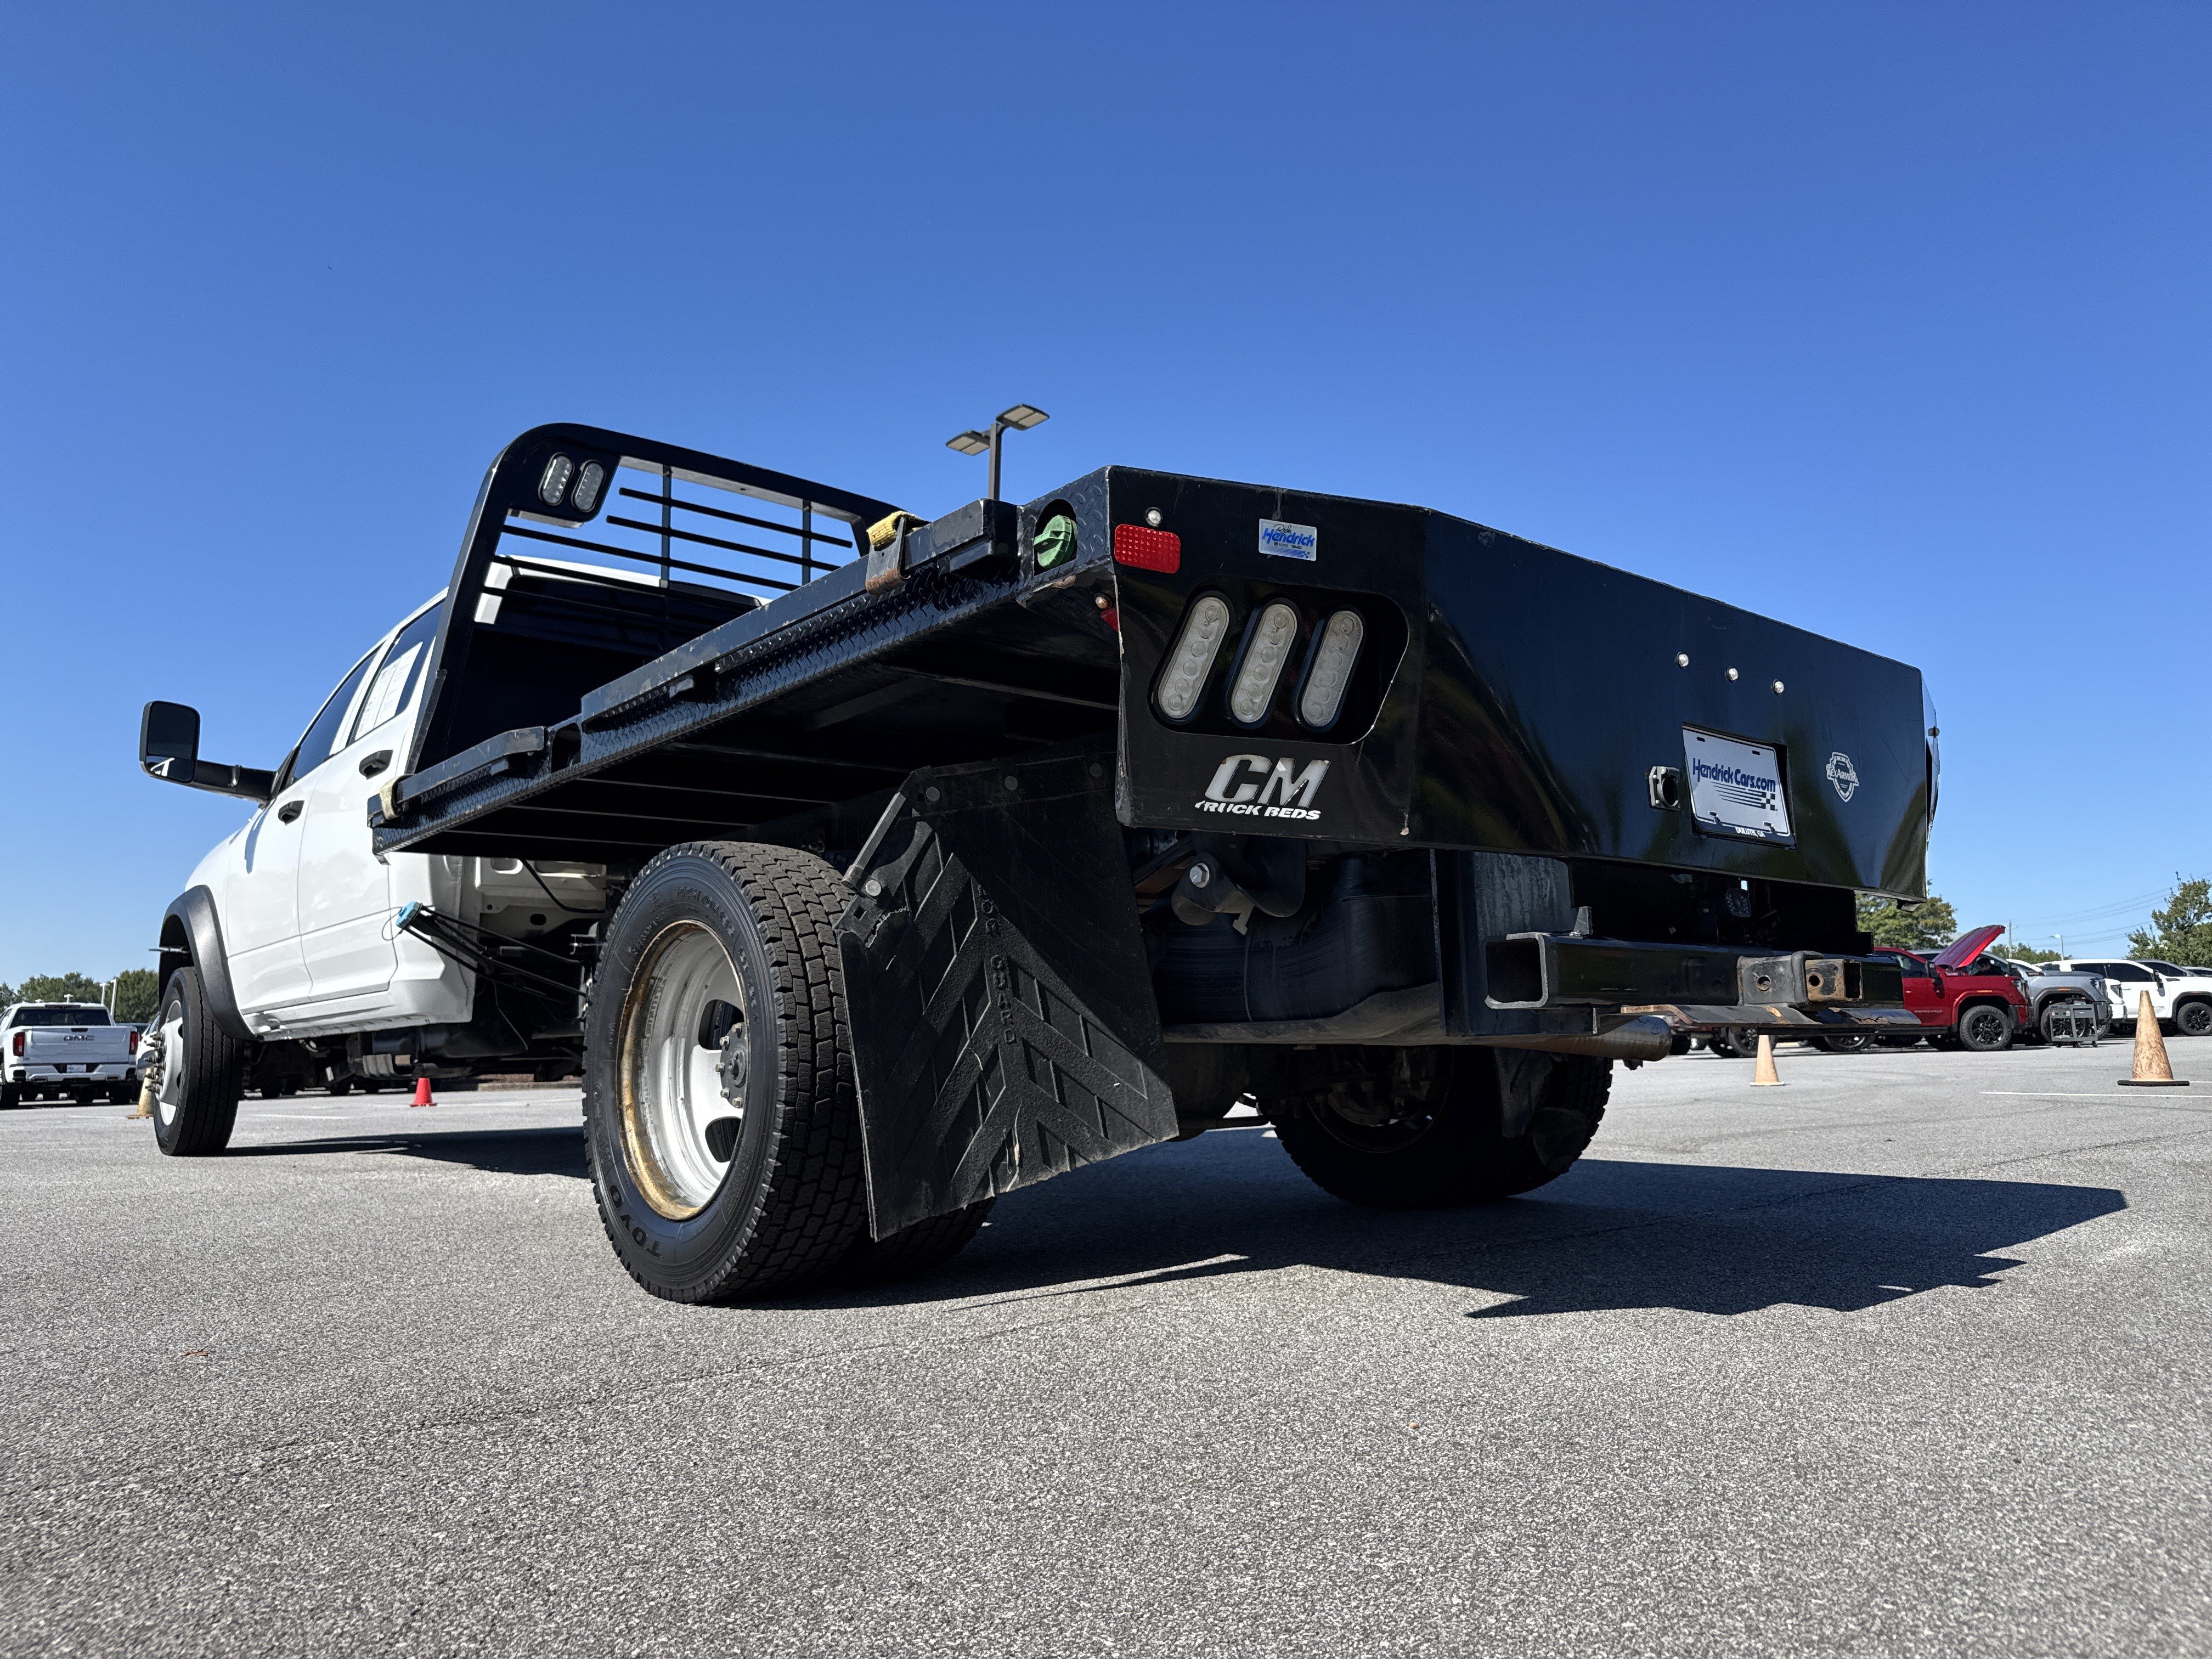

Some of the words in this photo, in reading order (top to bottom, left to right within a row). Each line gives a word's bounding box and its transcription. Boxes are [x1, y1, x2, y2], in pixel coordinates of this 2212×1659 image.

[1262, 528, 1315, 547] Hendrick
[1273, 524, 1292, 534] Rick
[1205, 754, 1331, 808] CM
[1194, 800, 1262, 816] TRUCK
[1264, 806, 1322, 820] BEDS
[990, 955, 1015, 1044] GUARD
[610, 1184, 663, 1260] TOYO
